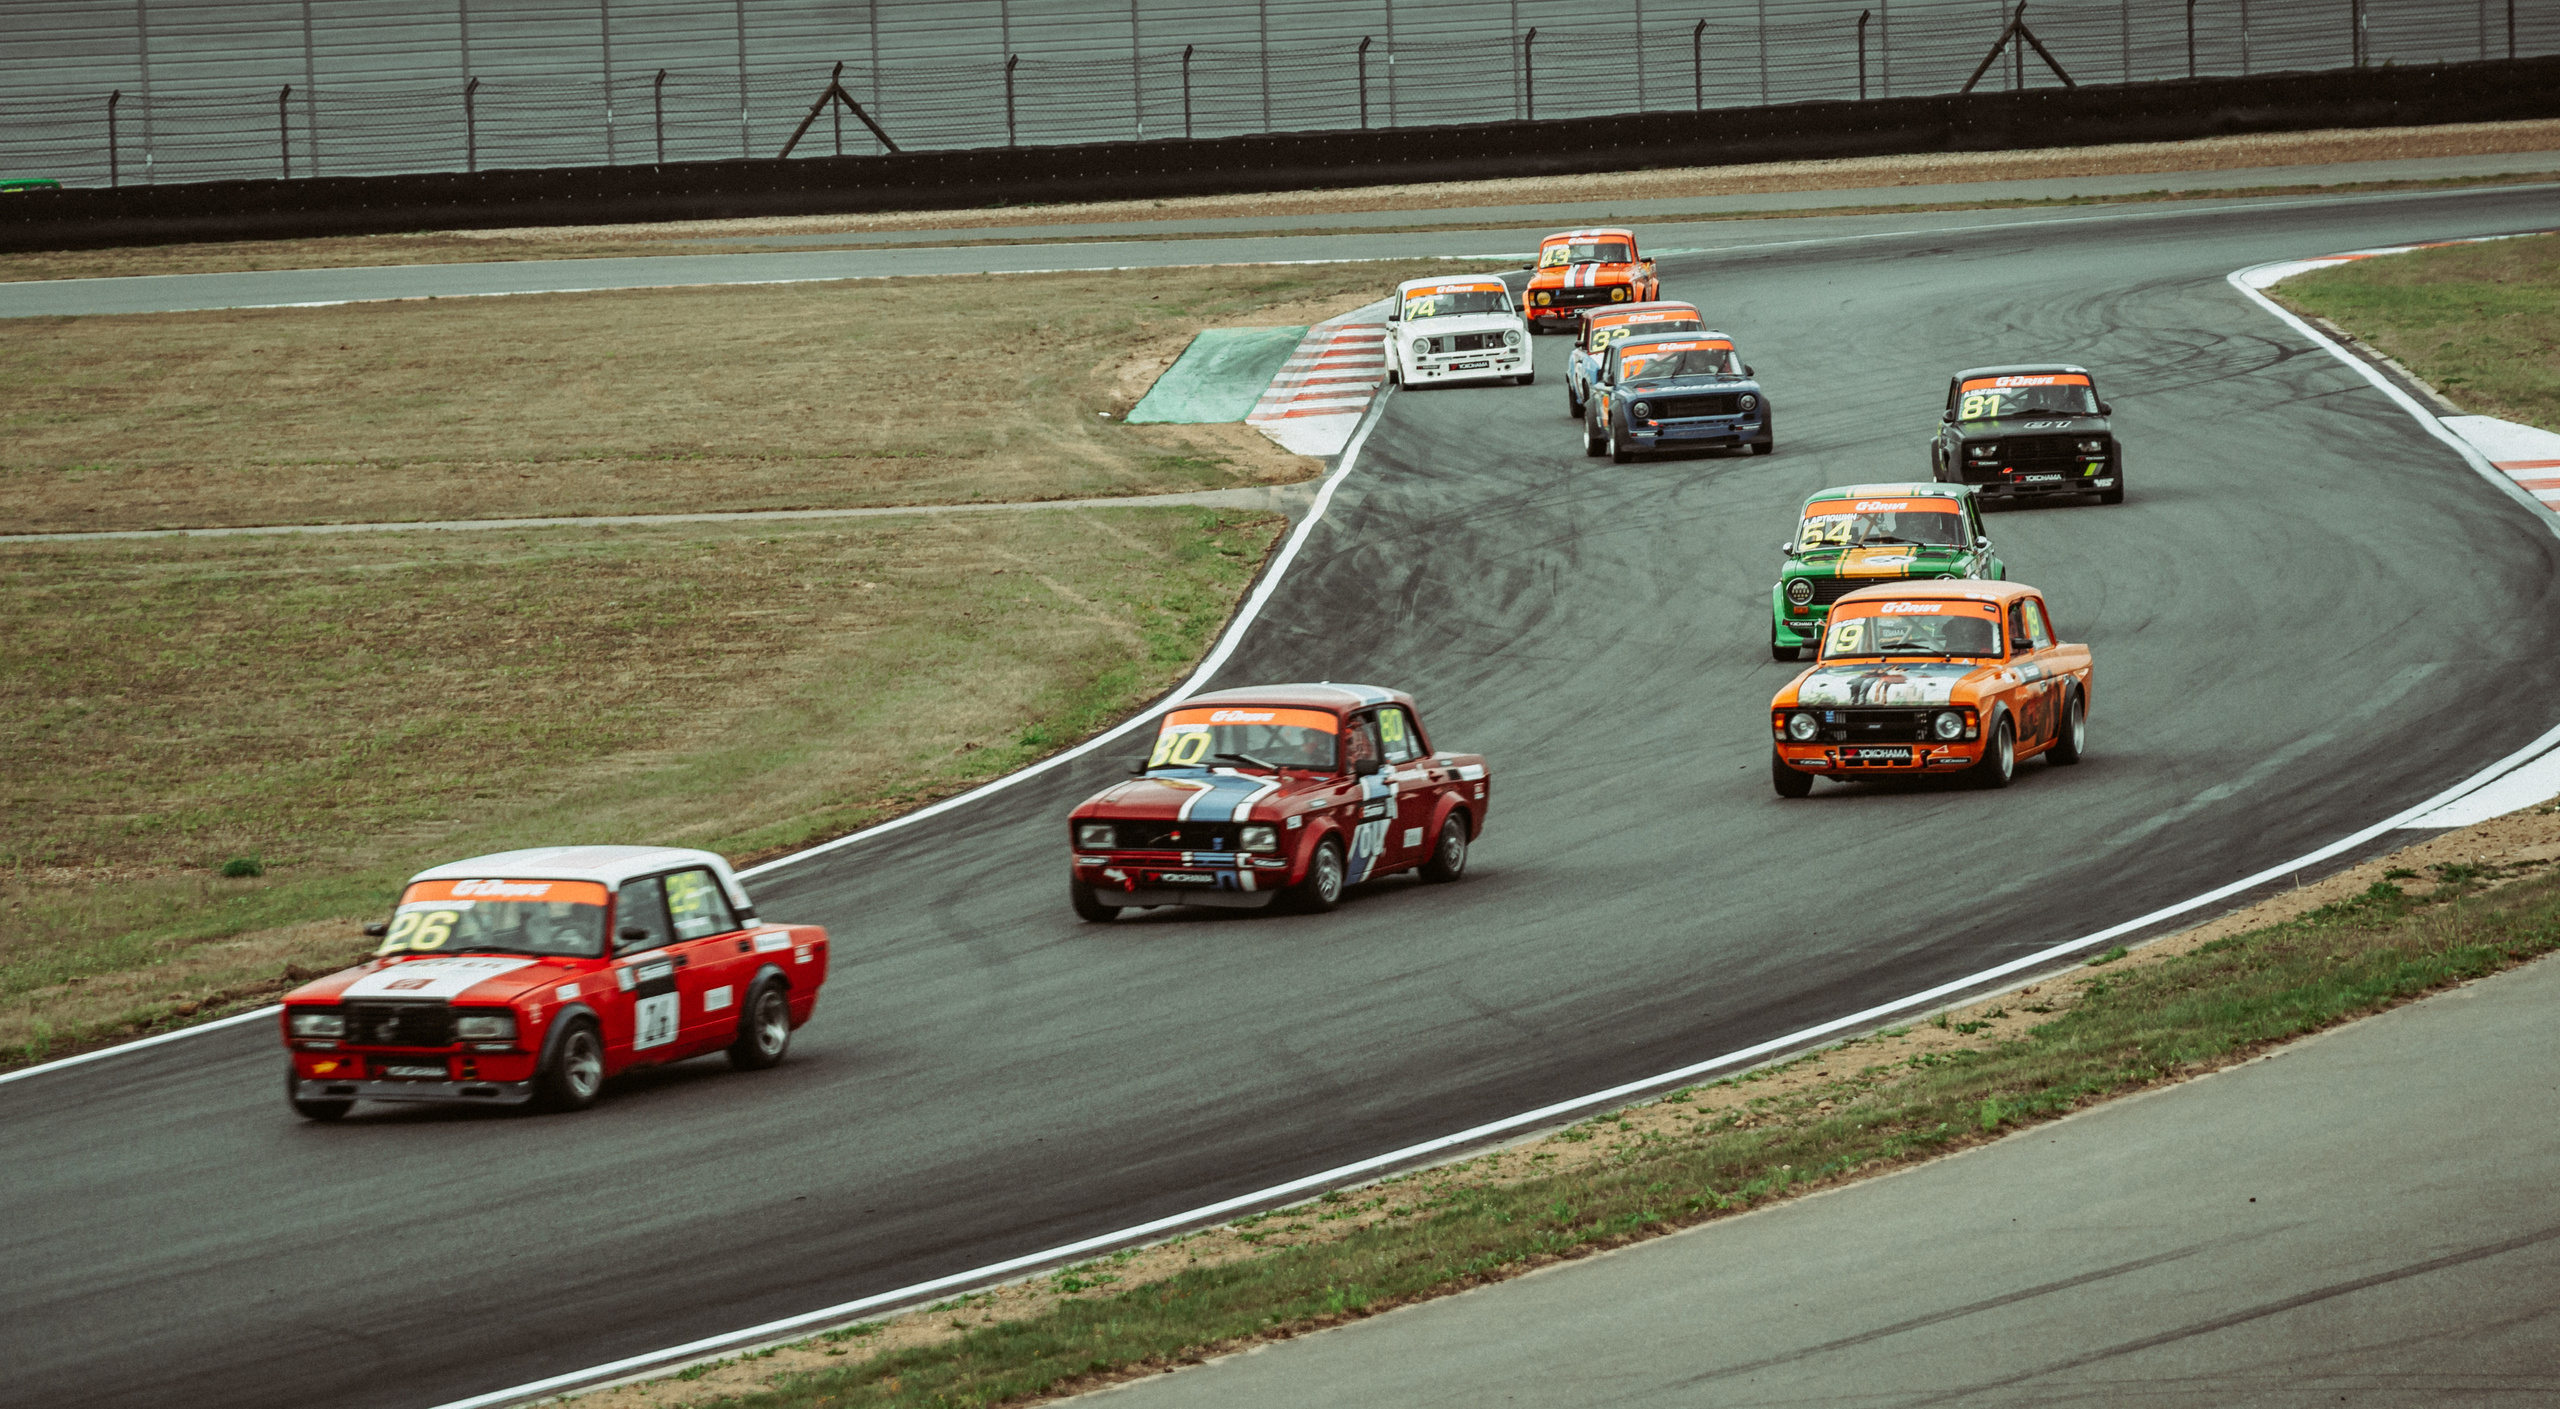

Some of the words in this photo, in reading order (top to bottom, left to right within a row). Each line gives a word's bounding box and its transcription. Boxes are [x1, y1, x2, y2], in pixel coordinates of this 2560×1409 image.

[1541, 248, 1570, 267] 43
[1405, 299, 1436, 321] 74
[1459, 361, 1488, 370] YOKOHAMA
[1623, 359, 1646, 379] 17
[1961, 394, 2001, 420] 81
[2025, 474, 2062, 482] YOKOHAMA
[1799, 520, 1853, 550] 54
[2026, 605, 2040, 637] 19
[1825, 625, 1864, 656] 19
[1147, 731, 1211, 767] 80
[1858, 749, 1909, 758] YOKOHAMA
[378, 910, 459, 956] 26
